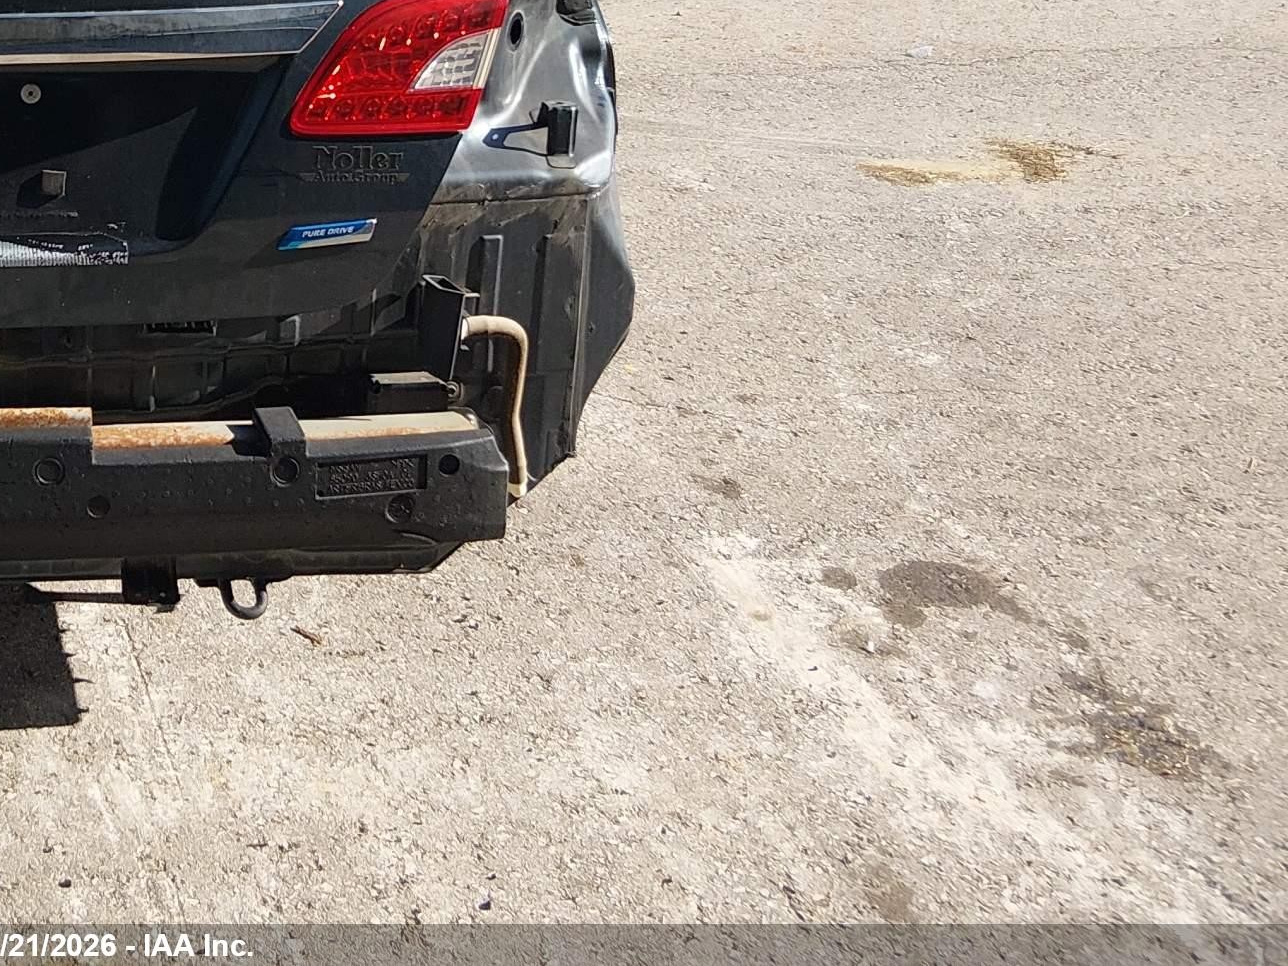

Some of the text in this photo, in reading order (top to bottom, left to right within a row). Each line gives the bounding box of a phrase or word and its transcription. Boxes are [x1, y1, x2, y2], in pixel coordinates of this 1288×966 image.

[311, 145, 404, 170] Noller
[313, 170, 398, 184] Auto Group
[302, 226, 355, 238] PURE DRIVE
